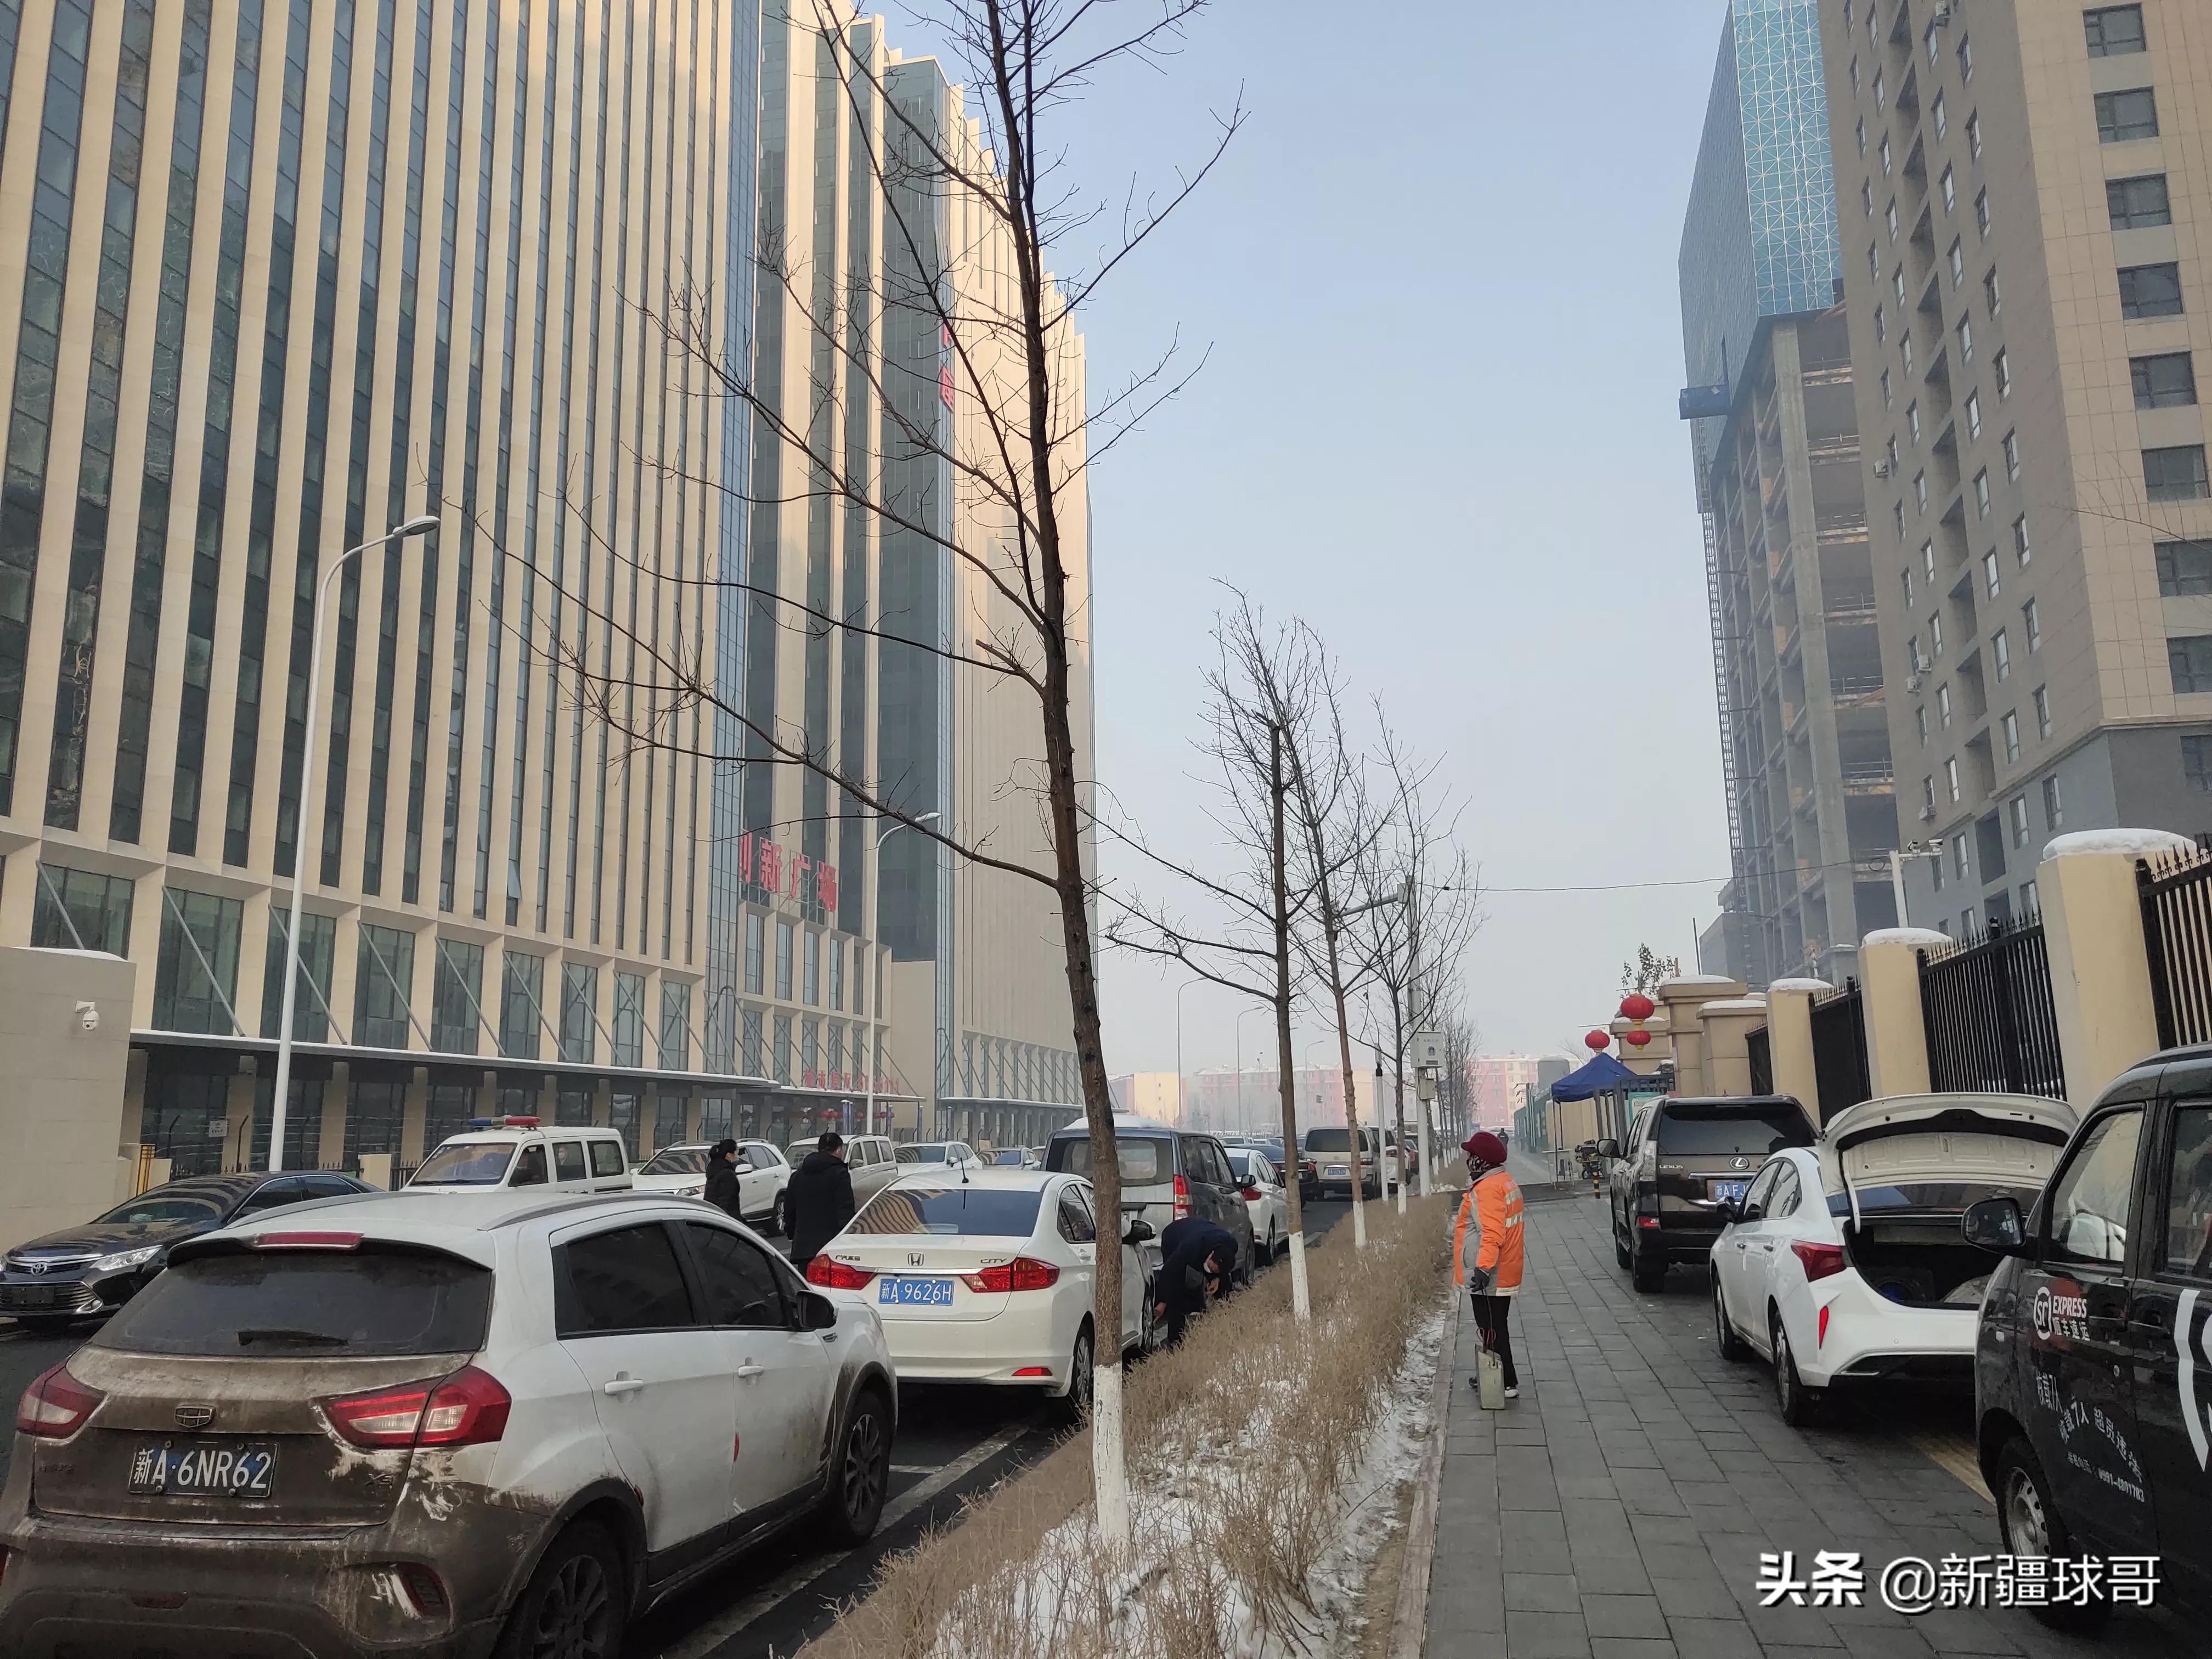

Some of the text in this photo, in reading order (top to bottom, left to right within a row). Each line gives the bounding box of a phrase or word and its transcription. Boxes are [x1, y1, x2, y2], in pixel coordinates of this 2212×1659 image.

[2053, 1295, 2087, 1318] EXPRESS
[2052, 1317, 2091, 1341] 顺丰速运
